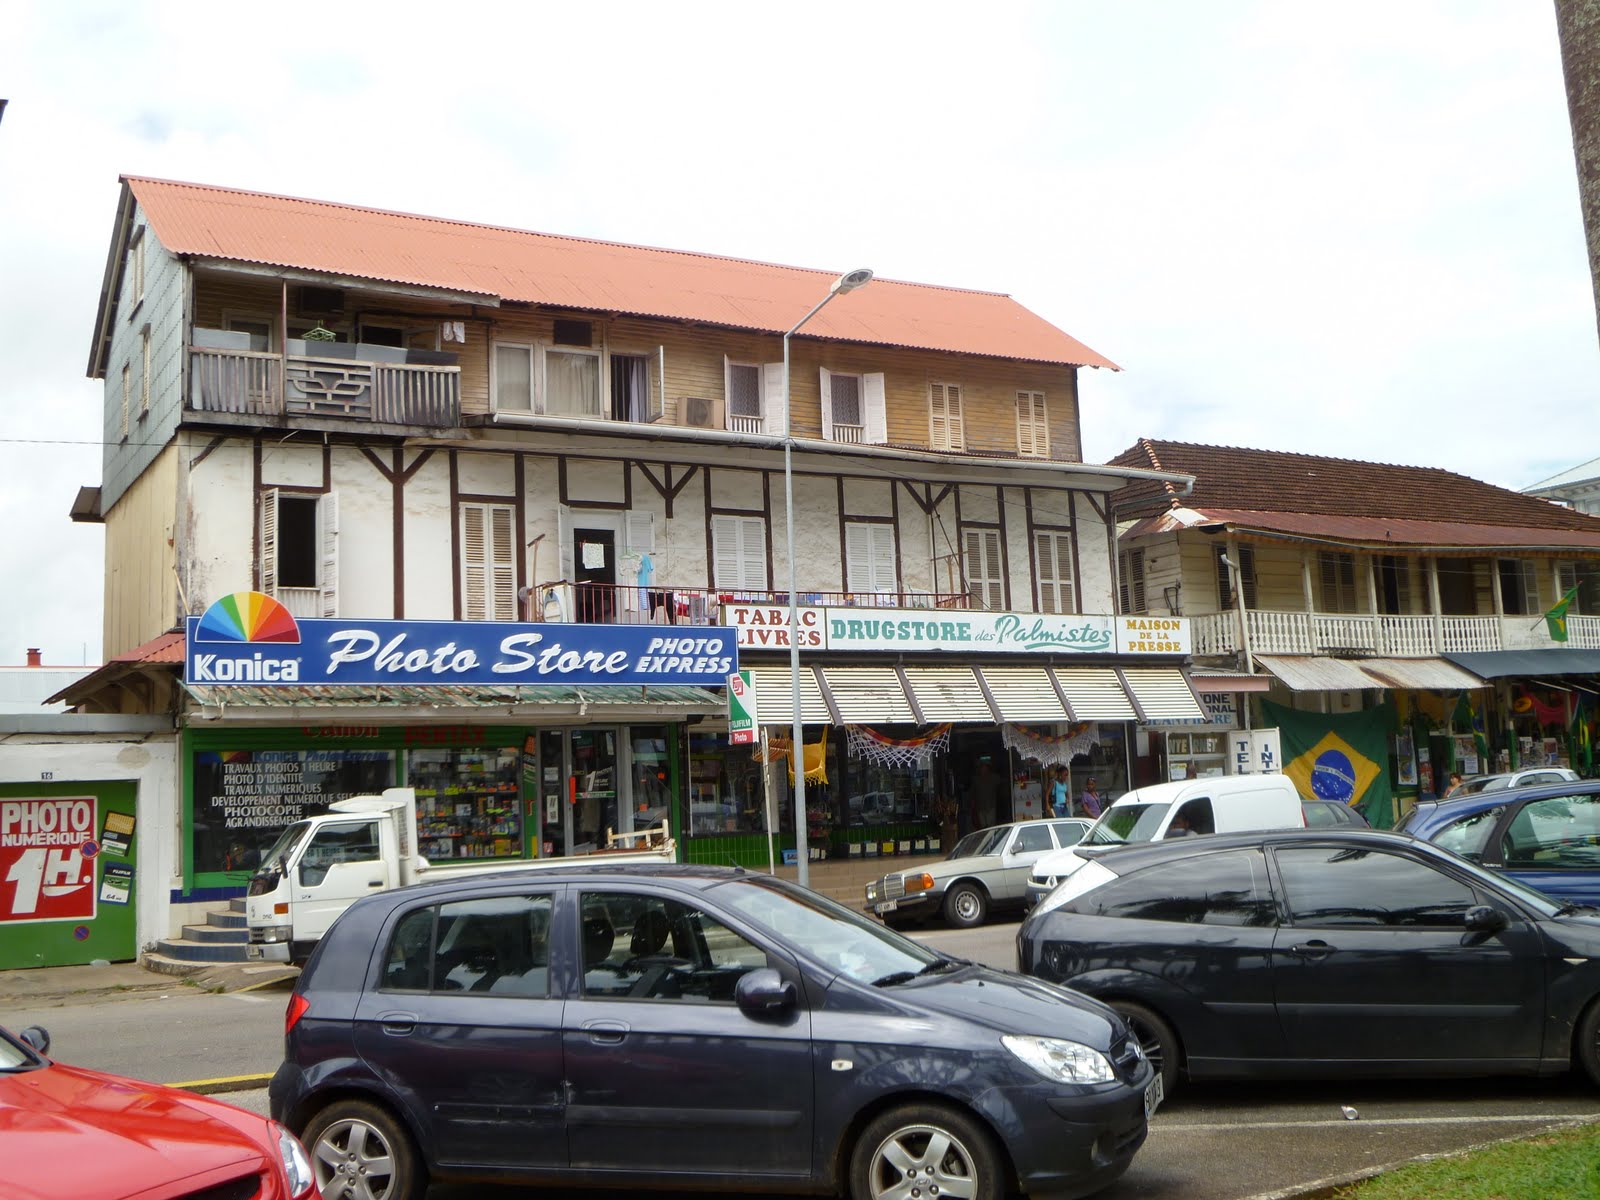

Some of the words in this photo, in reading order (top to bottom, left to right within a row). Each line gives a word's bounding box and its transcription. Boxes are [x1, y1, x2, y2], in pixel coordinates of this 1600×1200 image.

[830, 619, 971, 642] DRUGSTORE
[974, 629, 997, 642] des
[995, 614, 1112, 646] Palmistes
[1126, 619, 1181, 631] MAISON
[1139, 632, 1152, 640] DE
[1157, 632, 1169, 640] LA
[326, 629, 480, 674] Photo
[491, 632, 629, 674] Store
[646, 637, 724, 655] PHOTO
[1128, 641, 1182, 652] PRESSE
[194, 652, 299, 681] Konica
[634, 656, 733, 674] EXPRESS
[1199, 693, 1230, 704] ONE
[734, 733, 748, 742] Photo
[224, 763, 262, 774] TRAVAUX
[264, 762, 299, 773] PHOTOS
[301, 762, 306, 772] 1
[308, 761, 336, 772] HEURE
[43, 772, 52, 780] 16
[223, 774, 254, 785] PHOTO
[257, 773, 304, 784] D'IDENTITE
[225, 785, 263, 796] TRAVAUX
[265, 783, 322, 796] NUMERIQUES
[212, 795, 282, 807] DEVELOPPEMENT
[284, 792, 334, 805] NUMERIQUE
[224, 804, 303, 817] PHOTOCOPIE
[1, 801, 91, 834] PHOTO
[225, 815, 304, 828] AGRANDISSEMENT
[1, 831, 91, 847] NUMÉRIQUE
